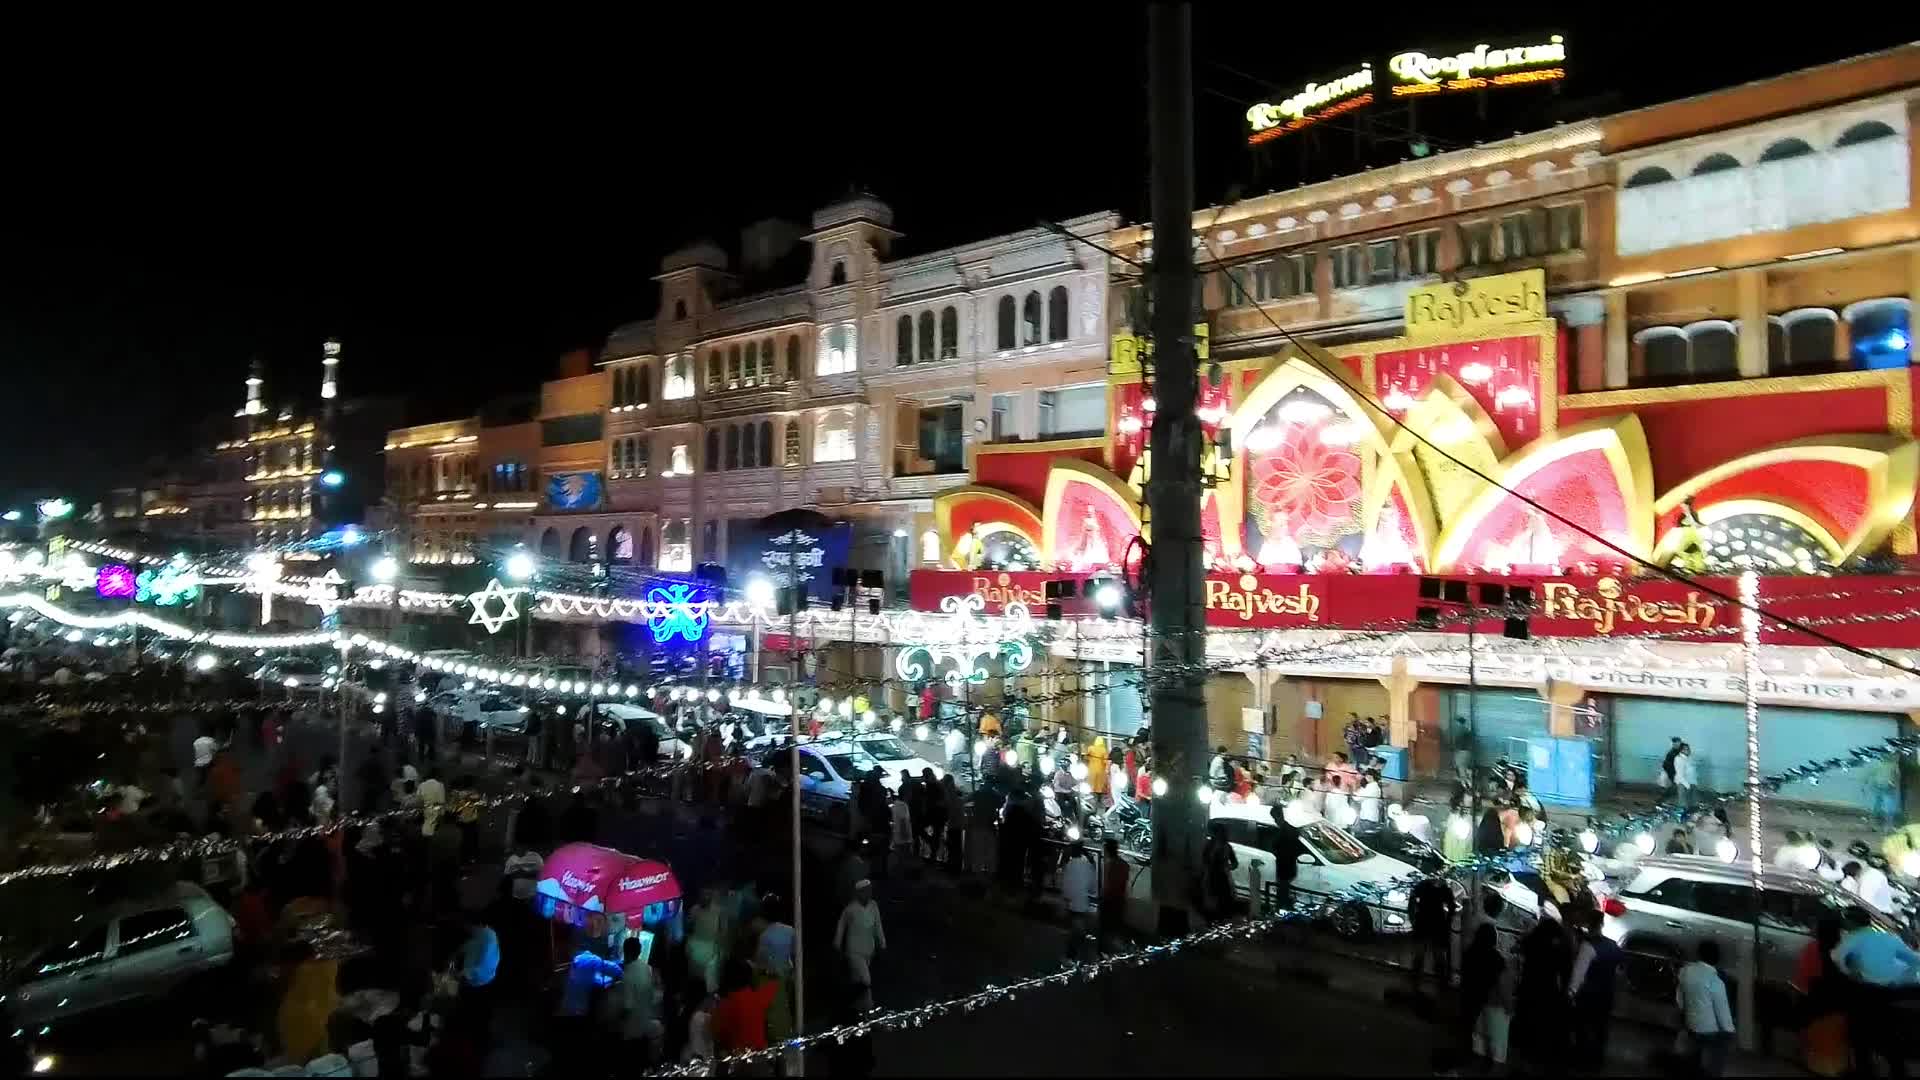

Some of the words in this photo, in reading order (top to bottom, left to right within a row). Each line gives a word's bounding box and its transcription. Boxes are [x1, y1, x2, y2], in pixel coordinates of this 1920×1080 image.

[1389, 35, 1566, 84] Rooplaxmi
[1408, 281, 1541, 328] Rajvesh
[1205, 574, 1321, 622] Rajvesh
[1541, 577, 1717, 634] Rajvesh
[618, 871, 670, 891] Havmor
